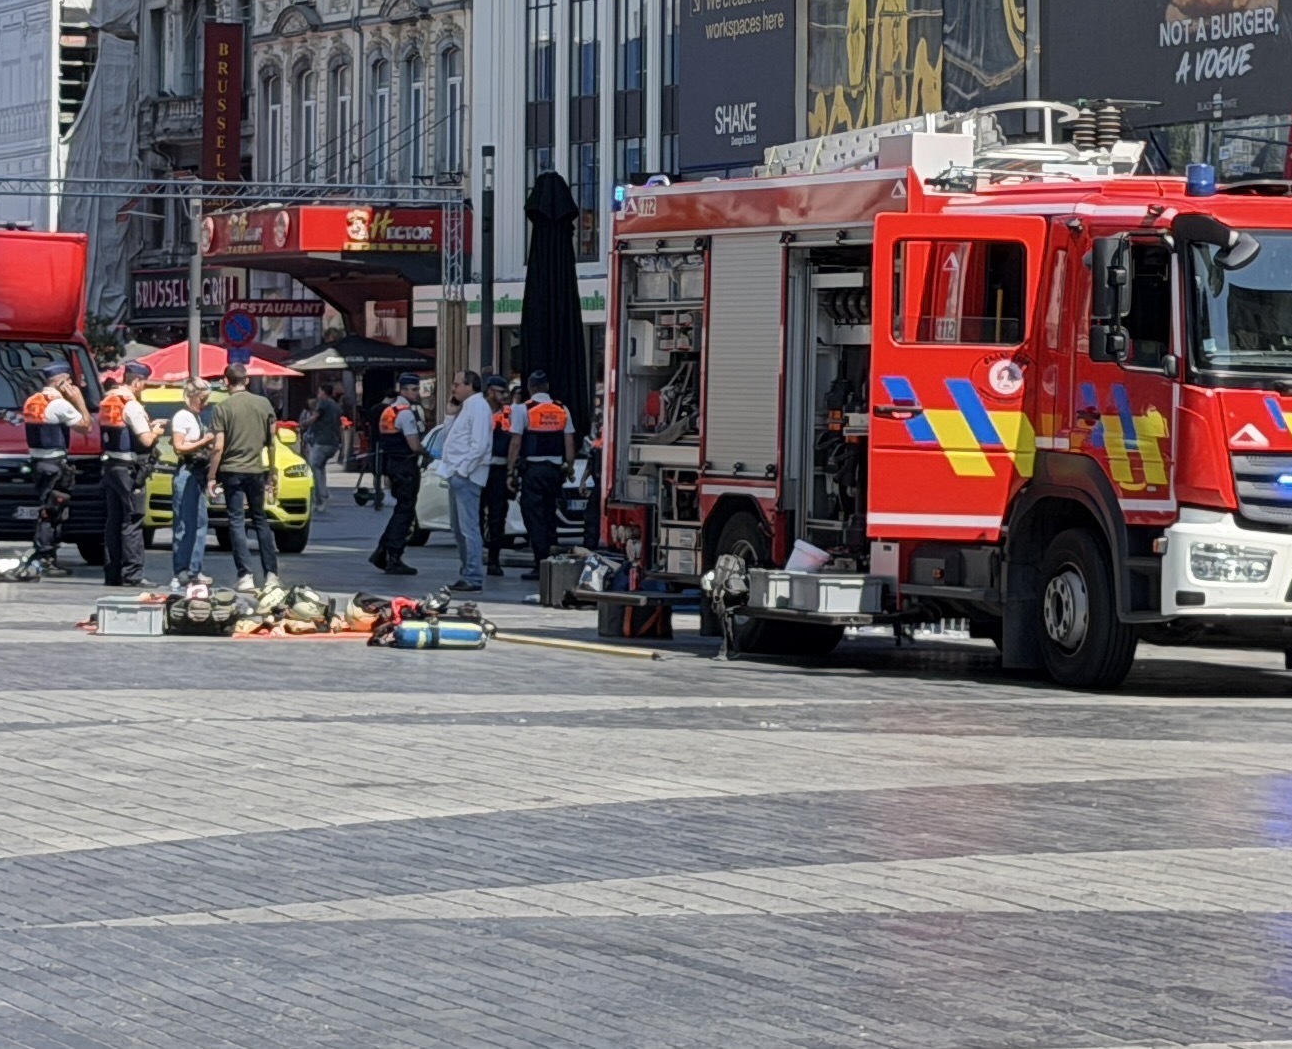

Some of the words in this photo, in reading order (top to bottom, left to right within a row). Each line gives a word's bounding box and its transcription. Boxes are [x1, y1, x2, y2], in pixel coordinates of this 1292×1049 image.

[705, 16, 761, 41] workspaces
[762, 10, 785, 31] here
[1159, 18, 1192, 48] NOT
[1195, 16, 1208, 43] A
[1210, 6, 1280, 42] BURGER,
[1175, 50, 1192, 85] A
[1195, 42, 1256, 83] VOGUE
[714, 101, 758, 135] SHAKE
[229, 301, 323, 315] RESTAURANT
